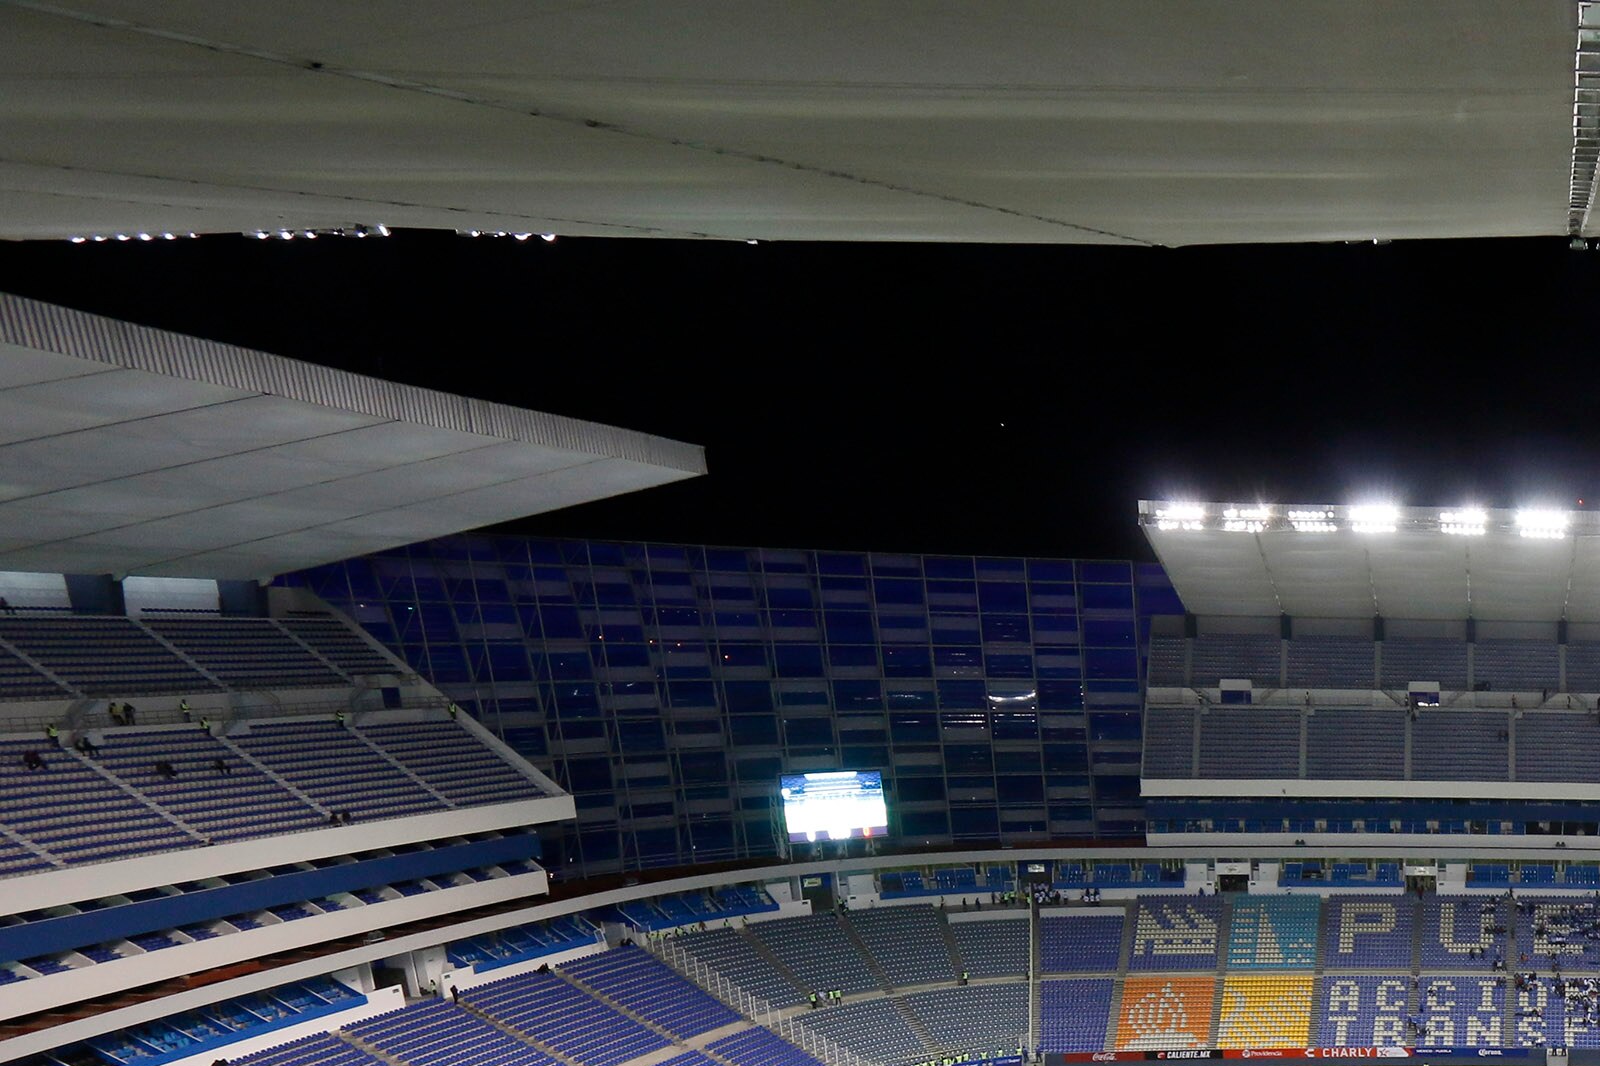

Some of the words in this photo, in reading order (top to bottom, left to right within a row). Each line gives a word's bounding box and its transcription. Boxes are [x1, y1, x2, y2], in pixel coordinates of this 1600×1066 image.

[1092, 1052, 1118, 1063] Coca-Cola
[1167, 1050, 1211, 1060] CALIENTE.MX
[1322, 1047, 1373, 1058] CHARLY
